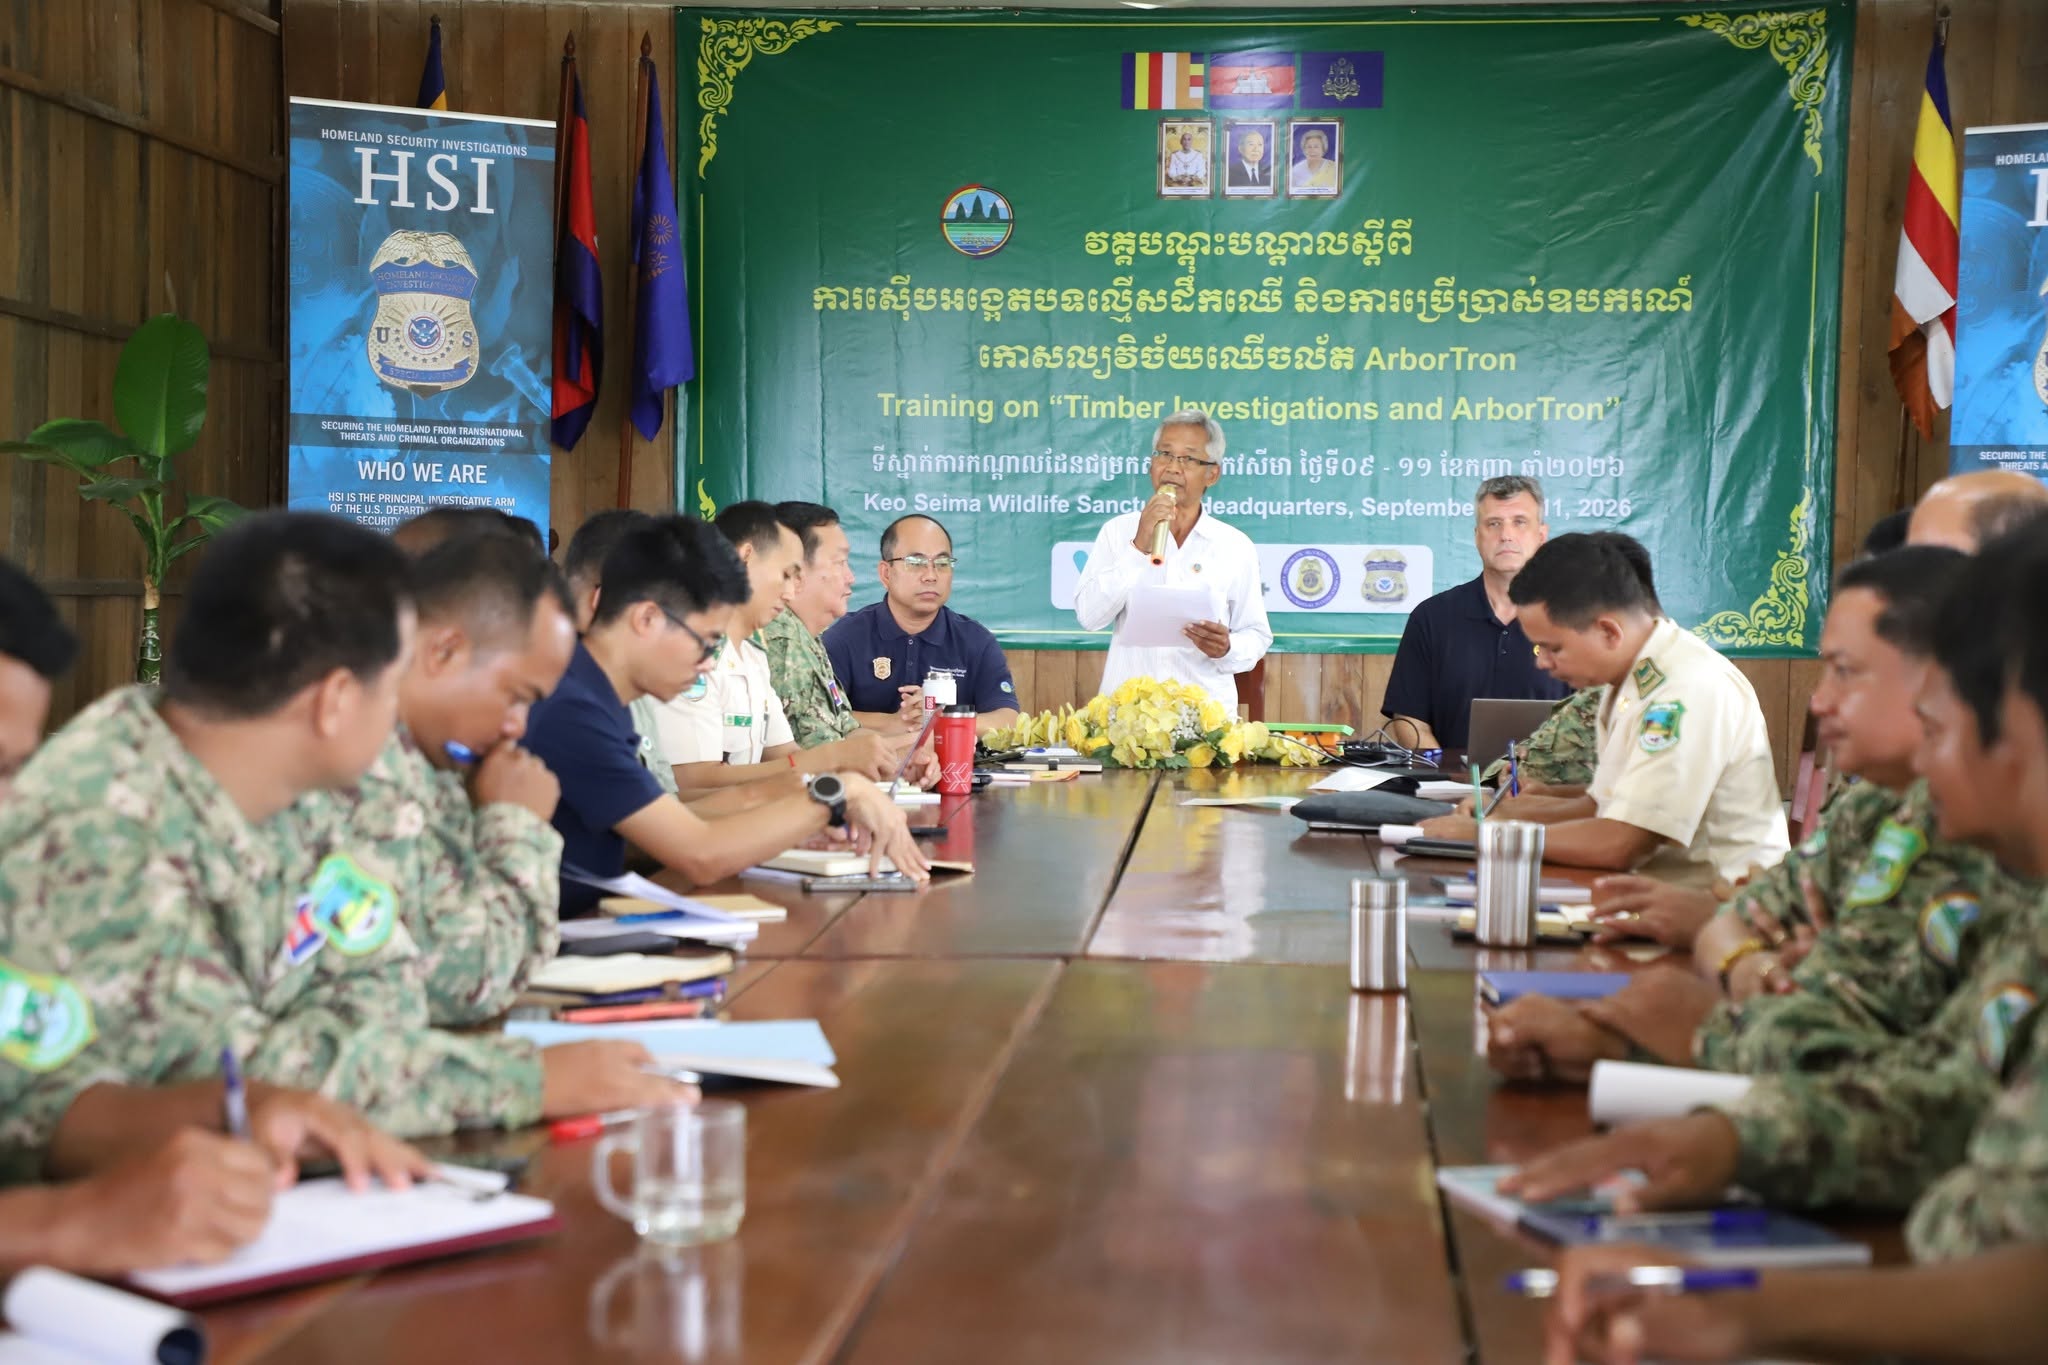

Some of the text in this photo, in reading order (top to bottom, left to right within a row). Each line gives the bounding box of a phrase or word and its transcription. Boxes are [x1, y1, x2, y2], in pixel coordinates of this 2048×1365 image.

[321, 128, 528, 157] HOMELAND SECURITY INVESTIGATIONS
[1995, 152, 2048, 166] HOMELA
[354, 147, 495, 214] HSI
[376, 327, 473, 348] U S
[1364, 346, 1516, 371] ArborTron
[877, 393, 994, 423] Training
[1003, 400, 1039, 418] on
[1050, 395, 1164, 419] “Timber
[1389, 398, 1443, 421] and
[1451, 396, 1620, 422] ArborTron”
[321, 421, 524, 438] SECURING THE HOMELAND FROM TRANSNATIONAL
[340, 431, 505, 447] THREATS AND CRIMINAL ORGANIZATIONS
[1979, 451, 2047, 460] SECURING THE
[358, 460, 488, 484] WHO WE ARE
[1399, 457, 1432, 476] ១១
[1999, 461, 2040, 471] THREATS
[328, 492, 515, 507] HSI IS THE PRINCIPAL INVESTIGATIVE ARM
[864, 494, 907, 512] Keo
[914, 494, 981, 513] Seima
[988, 494, 1070, 514] Wildlife
[1077, 495, 1149, 514] Sanct
[1361, 497, 1475, 520] Septembe
[1577, 498, 1632, 518] 2026
[330, 503, 431, 515] OF THE U.S. DEPARTM
[356, 515, 401, 526] SECURITY
